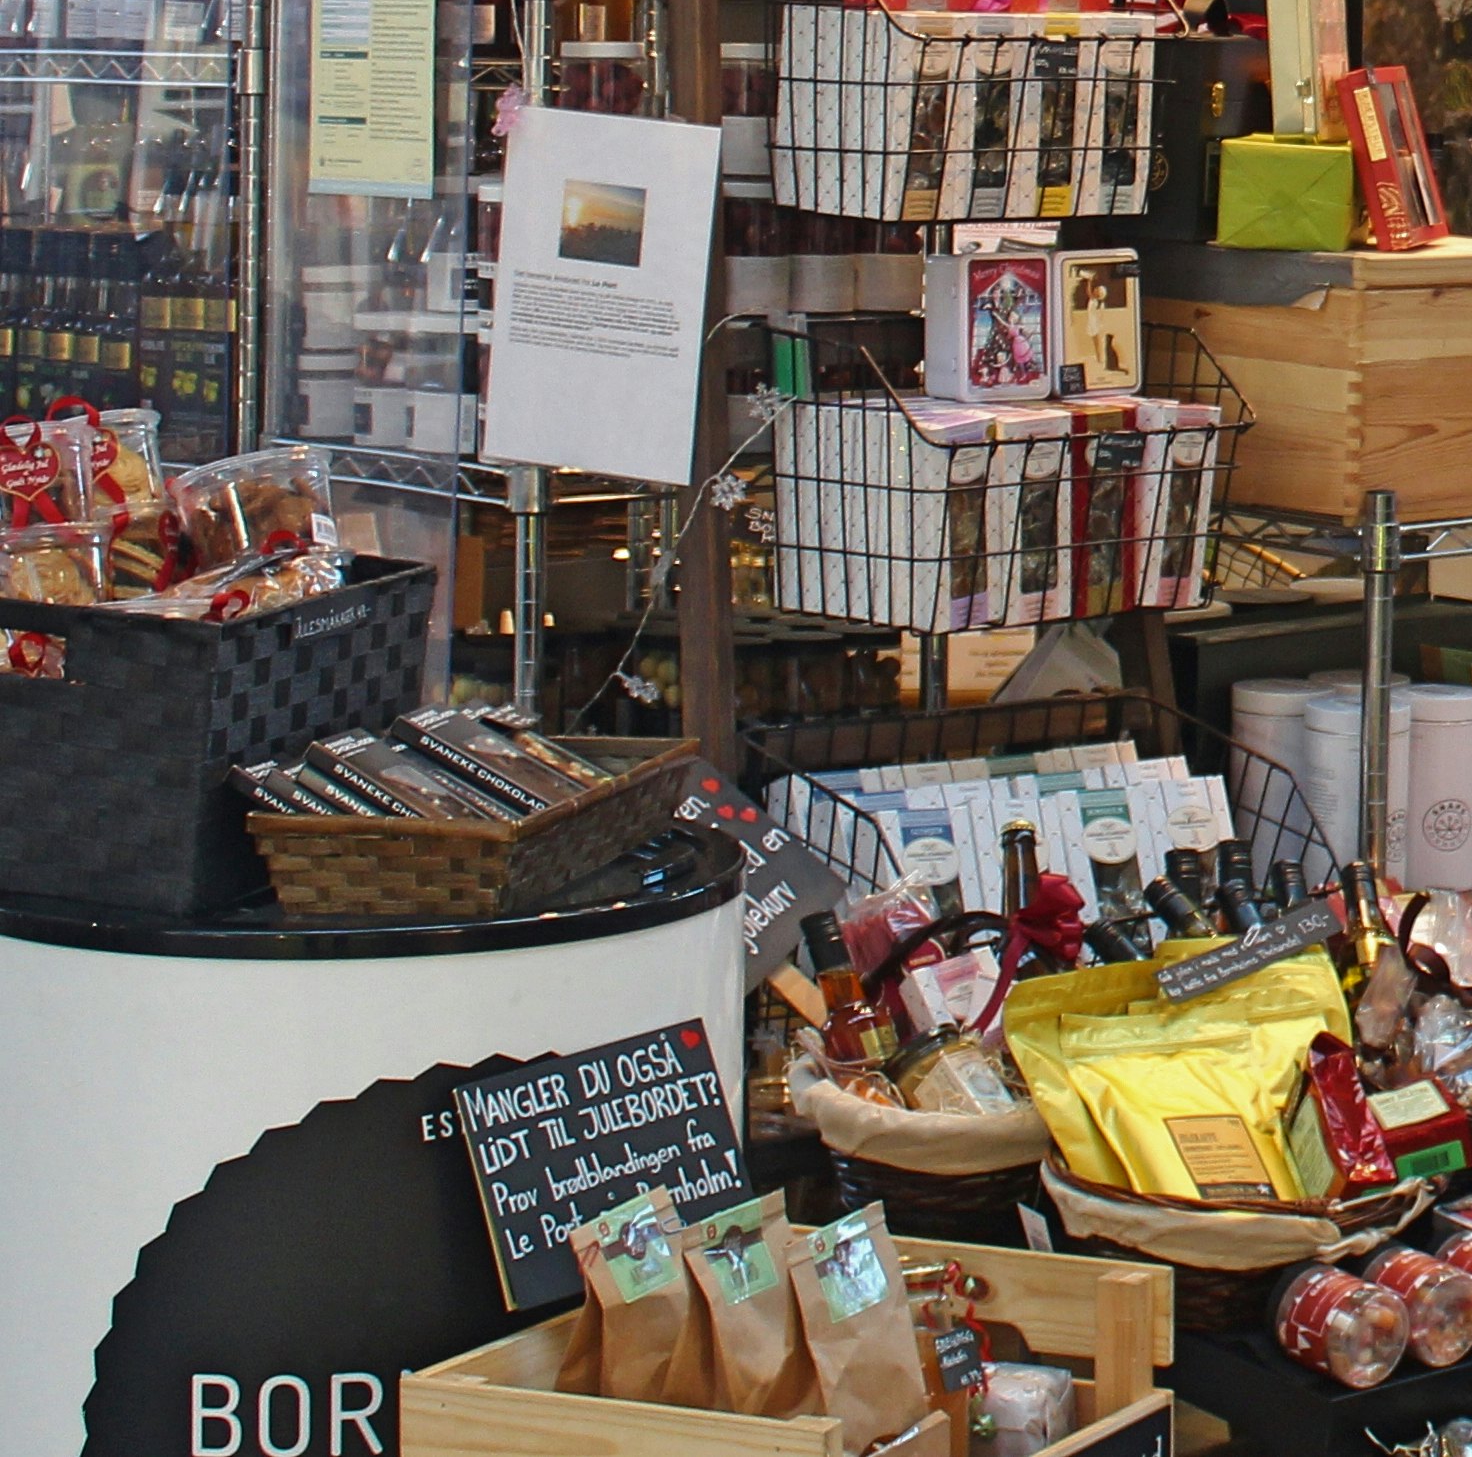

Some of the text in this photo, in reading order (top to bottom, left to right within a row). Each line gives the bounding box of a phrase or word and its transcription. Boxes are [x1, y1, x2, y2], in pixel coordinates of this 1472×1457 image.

[419, 734, 476, 775] SVANEKE
[333, 763, 393, 806] SVANEKE
[462, 1032, 684, 1133] MANGLER DU OGSÅ
[577, 1069, 722, 1141] JULEBORDET?
[686, 1118, 717, 1155] fra
[504, 1227, 534, 1262] Le
